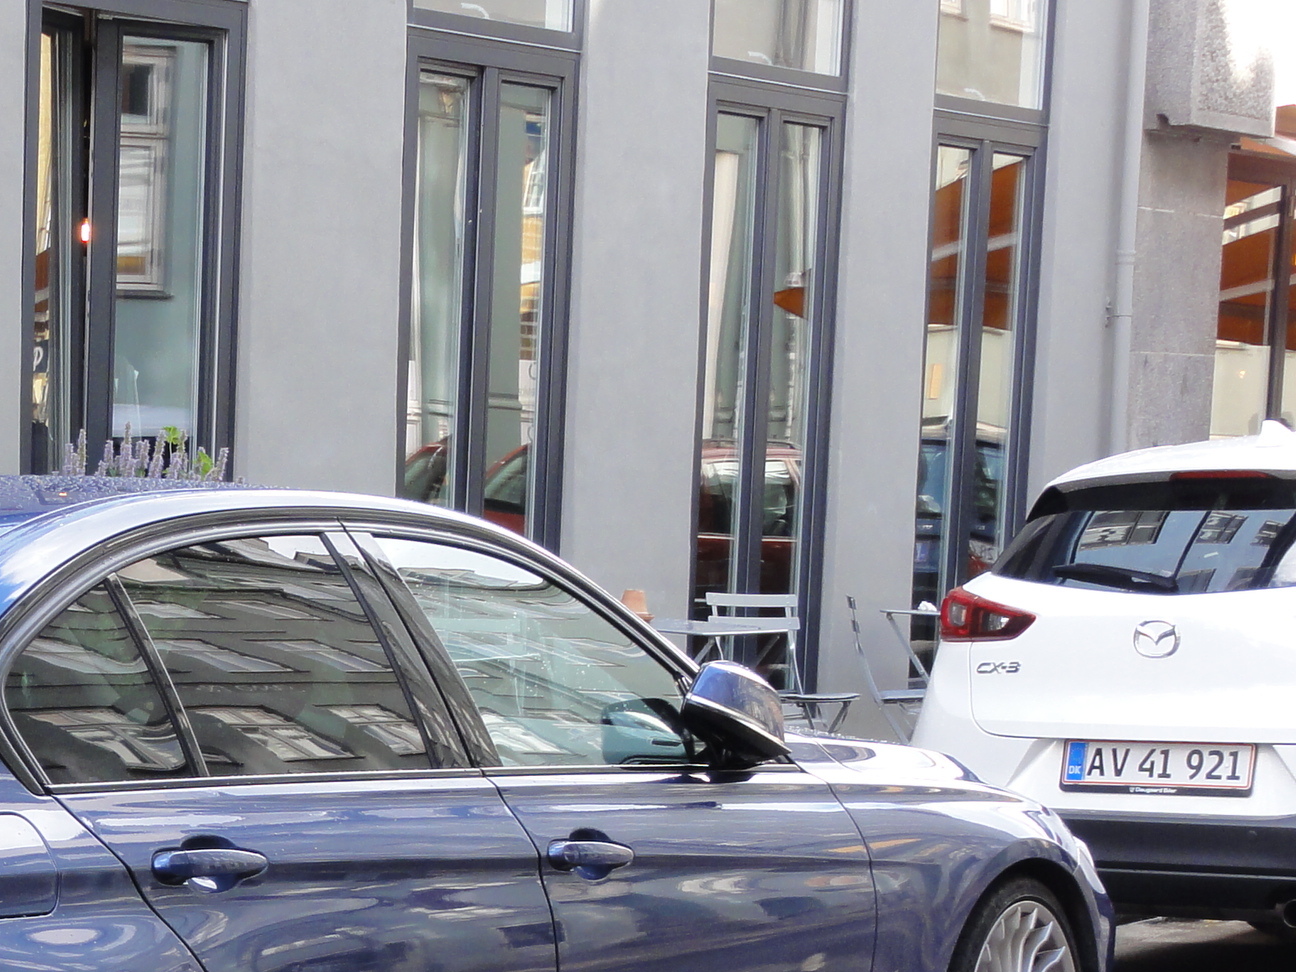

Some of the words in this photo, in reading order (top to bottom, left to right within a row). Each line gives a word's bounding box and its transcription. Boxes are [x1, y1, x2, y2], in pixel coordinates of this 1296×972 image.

[976, 661, 1022, 674] CX-3
[1068, 765, 1083, 775] DK
[1086, 747, 1131, 778] AV
[1137, 748, 1172, 779] 41
[1185, 748, 1242, 781] 921
